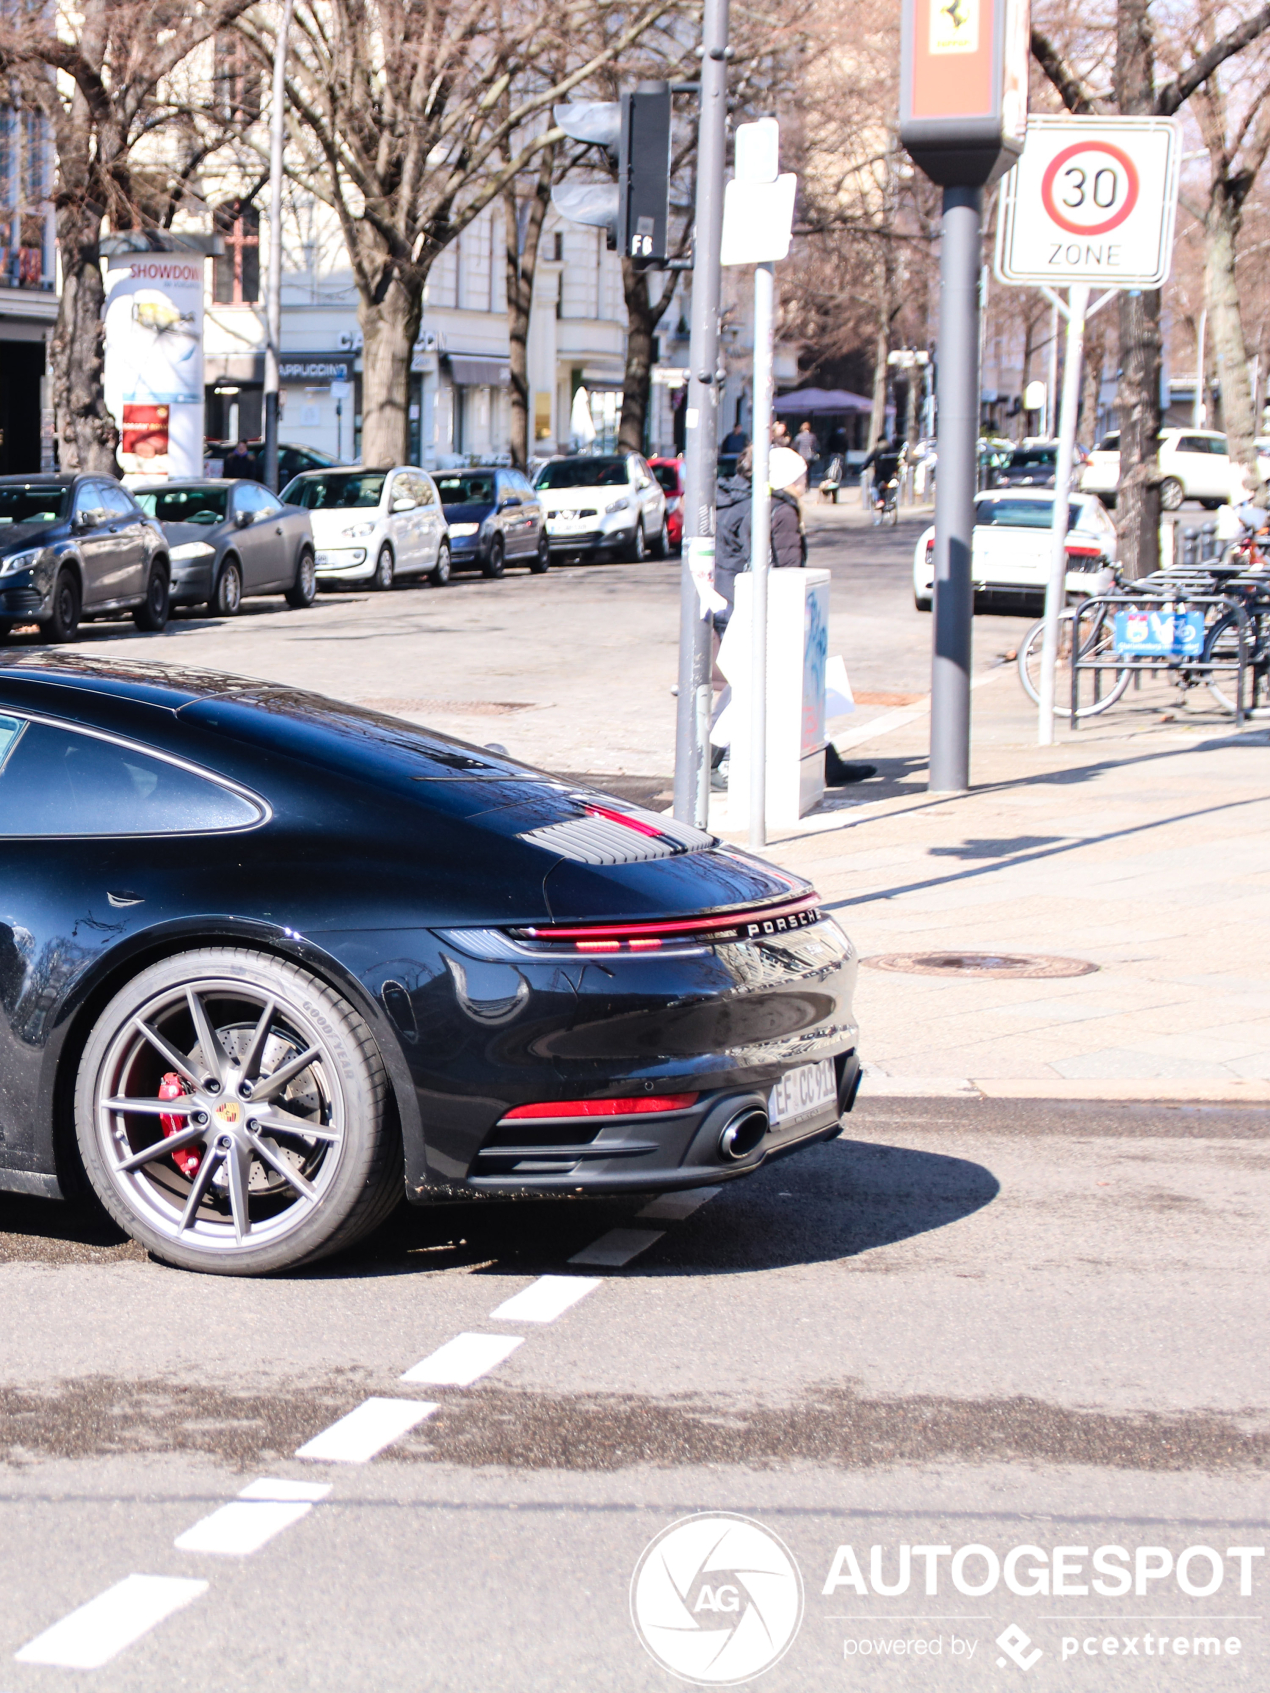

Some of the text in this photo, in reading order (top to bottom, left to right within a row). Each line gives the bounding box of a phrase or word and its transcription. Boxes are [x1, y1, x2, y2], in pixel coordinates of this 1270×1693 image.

[1062, 167, 1118, 208] 30
[1048, 243, 1122, 266] ZONE
[746, 907, 822, 937] PORSCHE
[776, 1057, 836, 1116] EF CC 911
